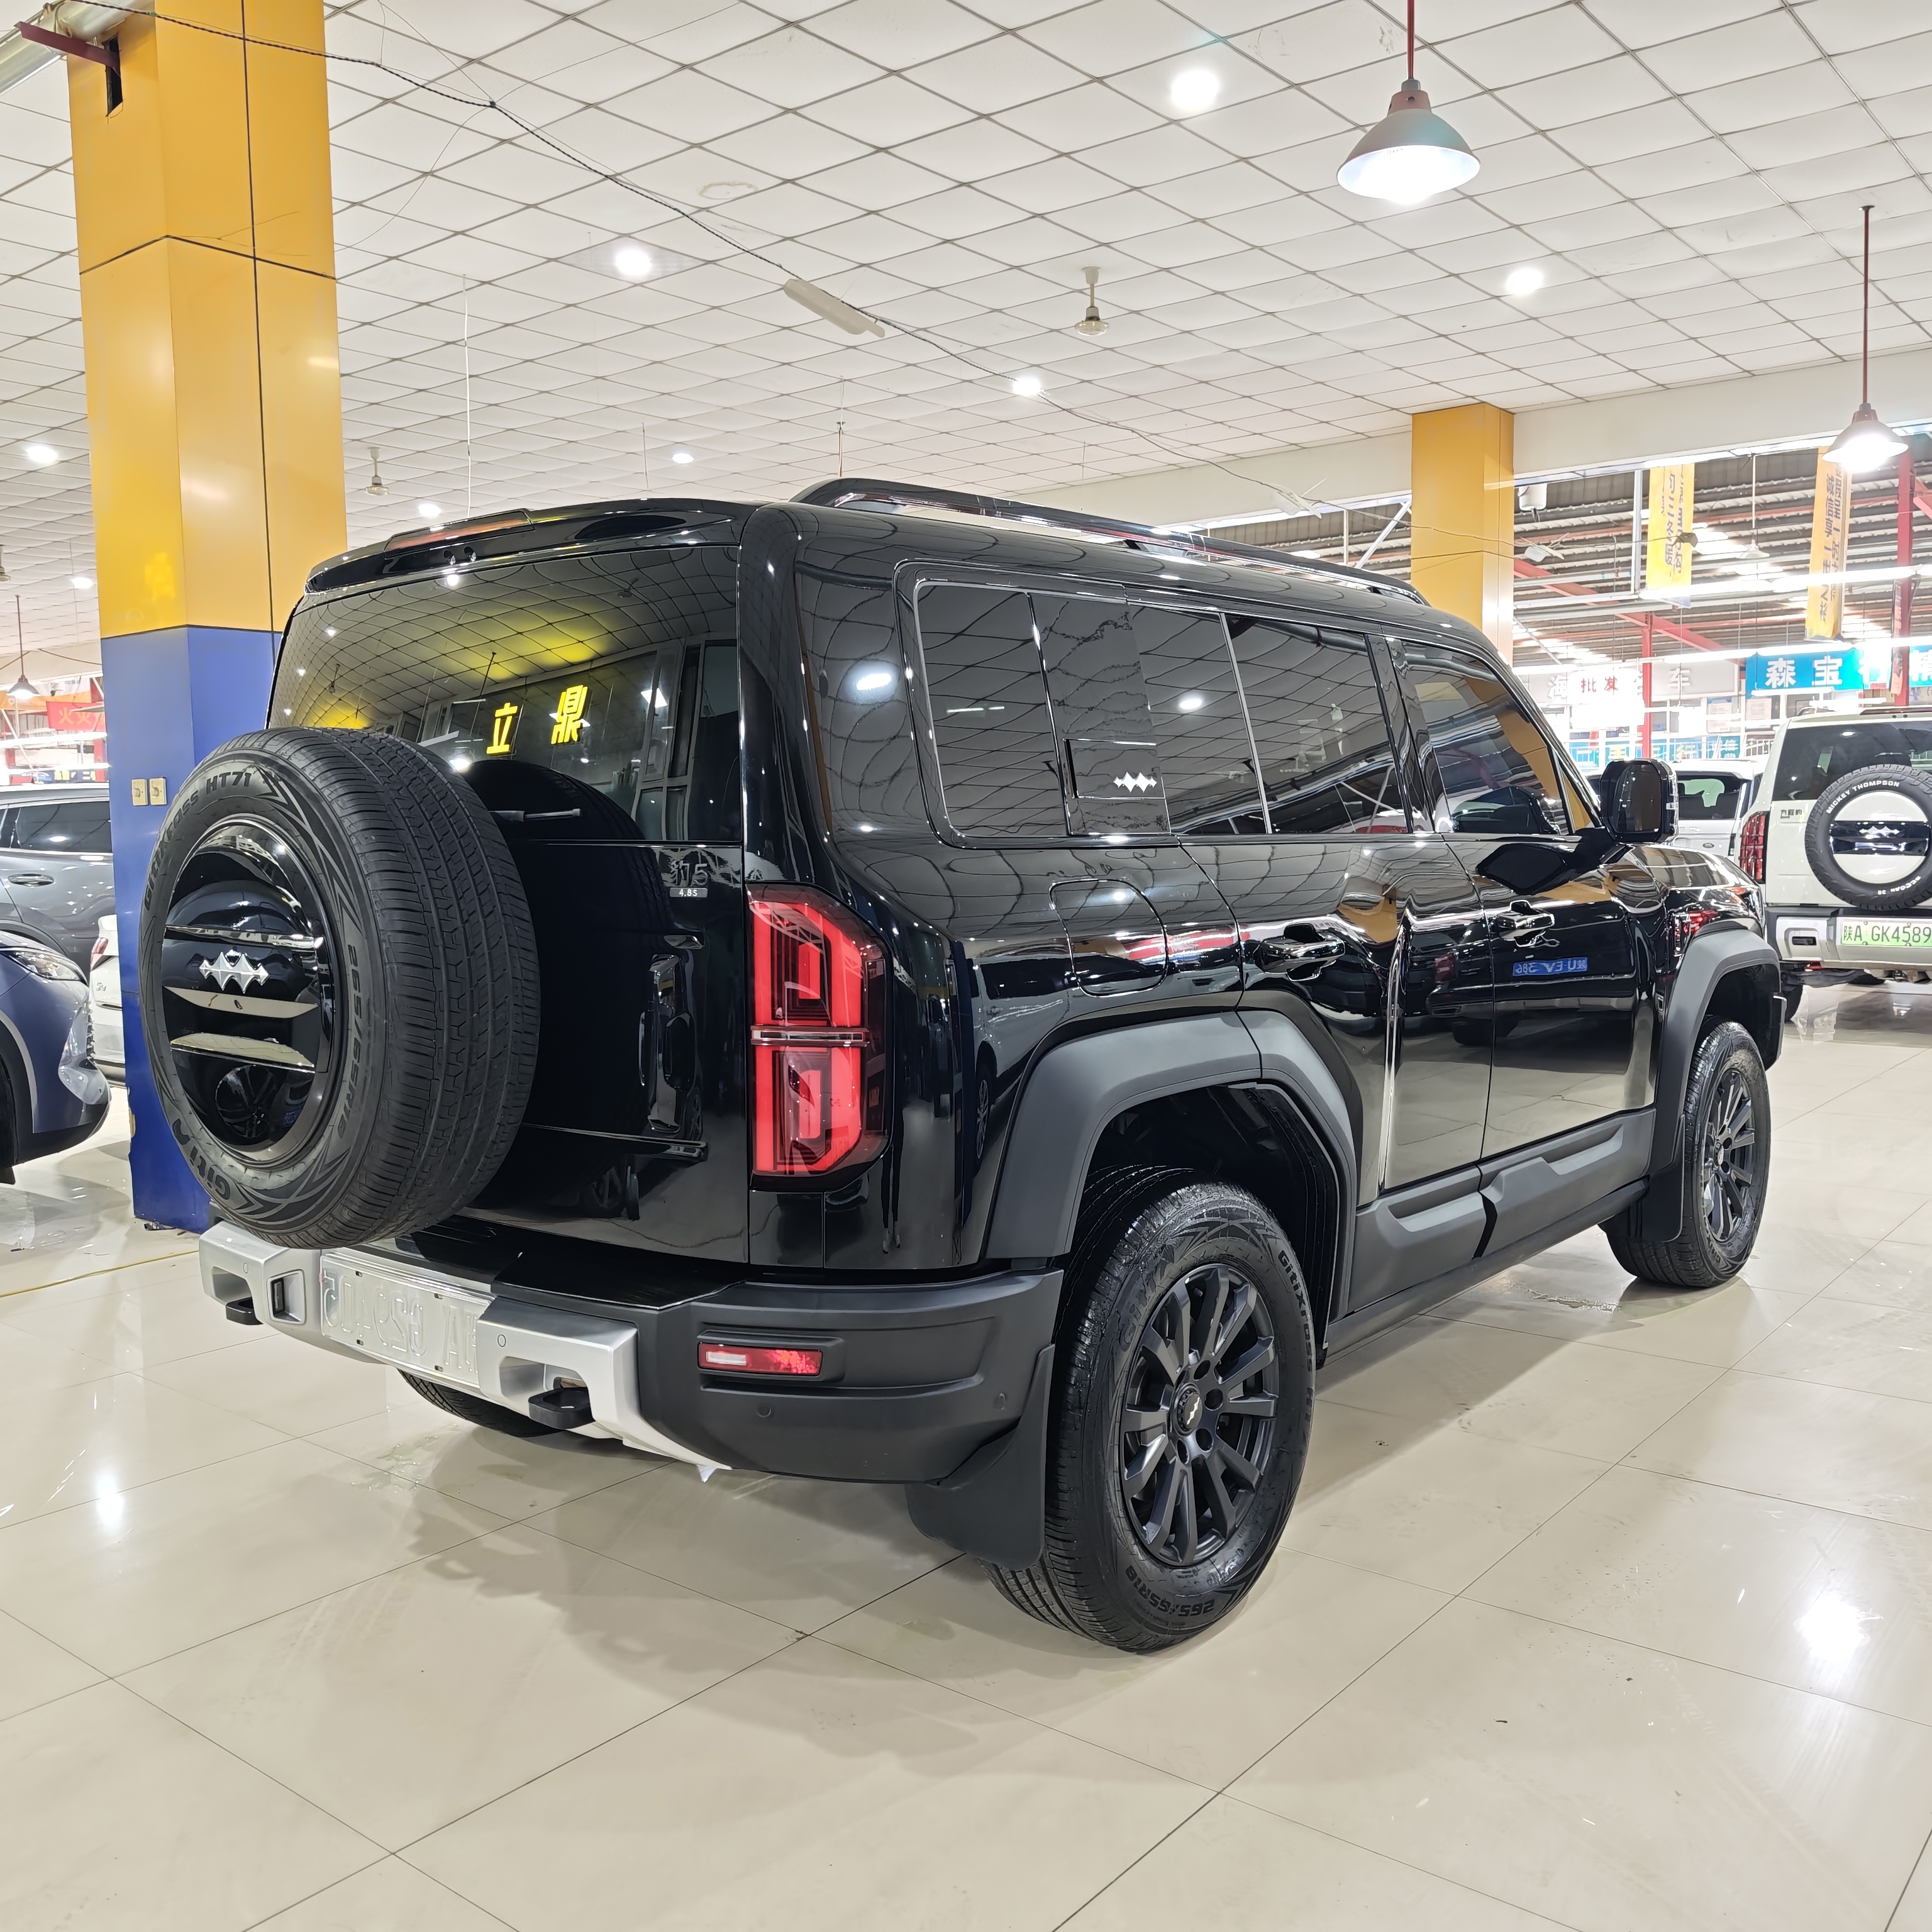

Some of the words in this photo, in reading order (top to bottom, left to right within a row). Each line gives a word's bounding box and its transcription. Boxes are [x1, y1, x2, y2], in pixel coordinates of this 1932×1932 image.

[206, 771, 252, 795] HT71
[1826, 789, 1851, 814] MICKEY
[1852, 780, 1900, 792] THOMPSON
[679, 889, 697, 897] 4.8S
[1871, 925, 1932, 943] GK4589
[189, 1145, 231, 1201] Giti
